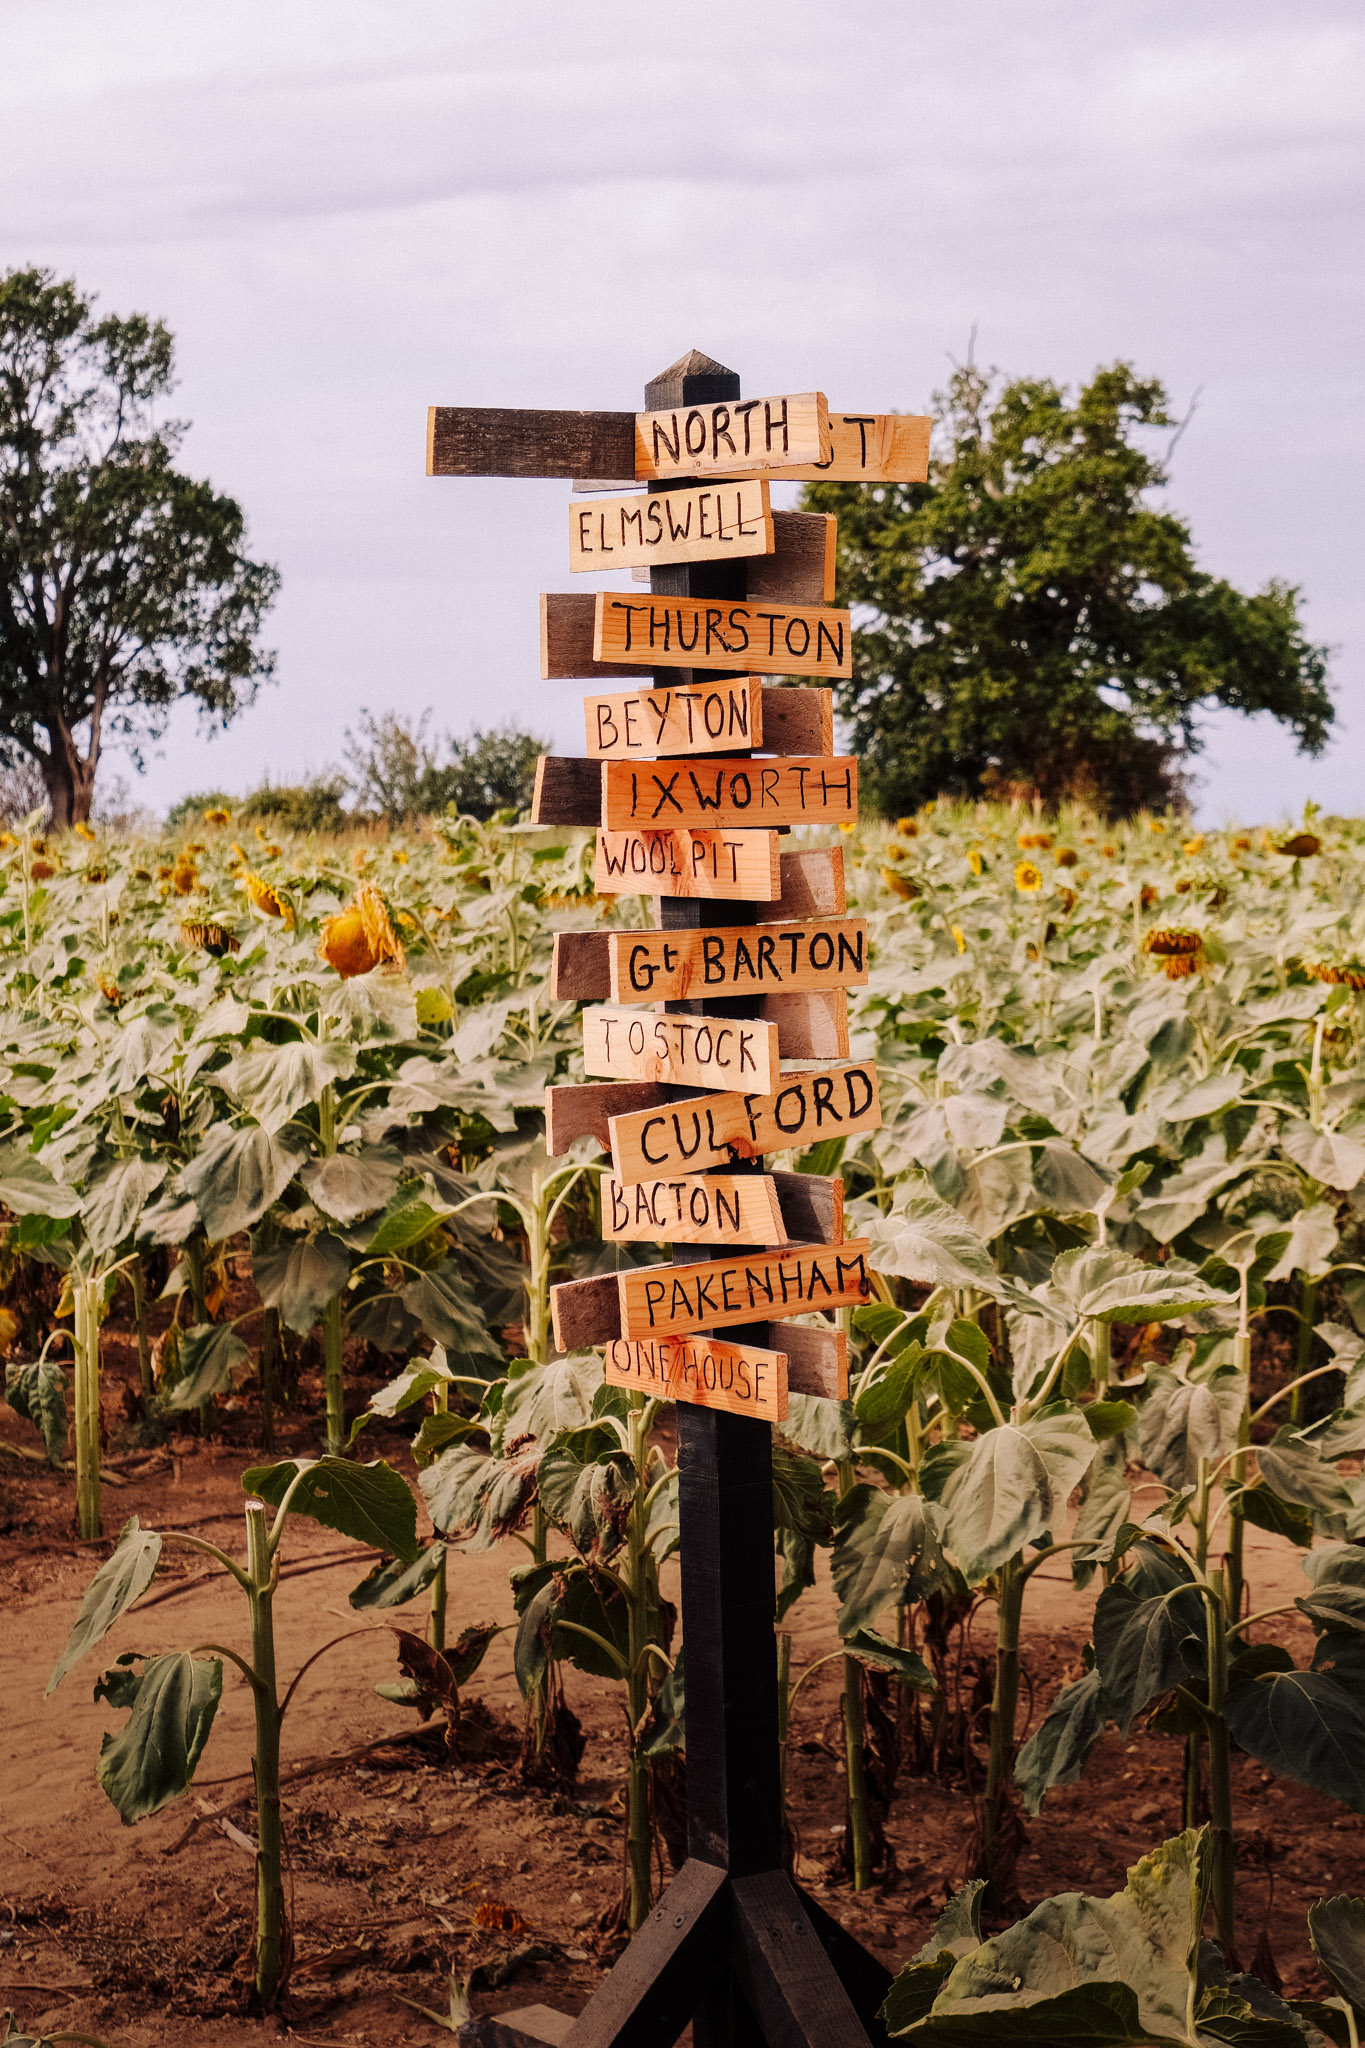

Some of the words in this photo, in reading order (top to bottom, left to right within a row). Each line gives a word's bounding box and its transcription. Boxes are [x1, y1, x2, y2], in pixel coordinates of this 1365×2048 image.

[652, 399, 789, 466] NORTH
[578, 491, 758, 553] ELMSWELL
[611, 602, 845, 666] THURSTON
[596, 688, 748, 750] BEYTON
[630, 767, 852, 818] IXWORTH
[601, 836, 744, 883] WOOLPIT
[629, 943, 678, 992] Gt
[702, 930, 864, 985] BARTON
[600, 1018, 757, 1073] TOSTOCK
[640, 1069, 874, 1165] CULFORD
[610, 1180, 741, 1232] BACTON
[645, 1254, 871, 1327] PAKENHAM
